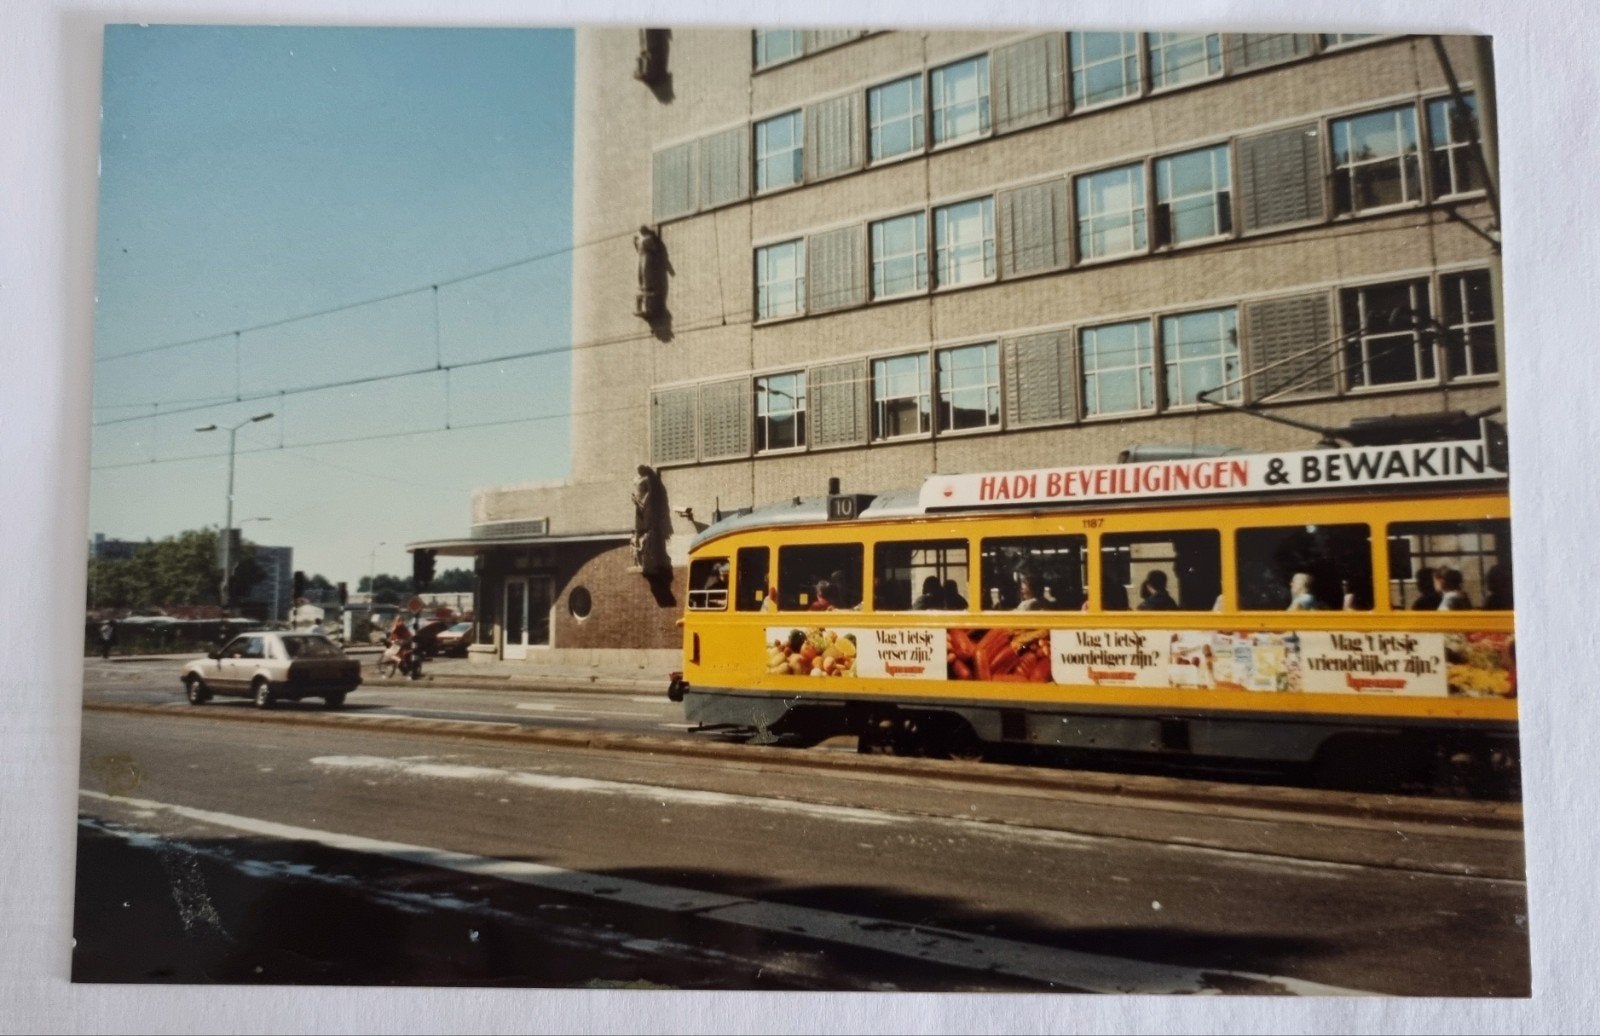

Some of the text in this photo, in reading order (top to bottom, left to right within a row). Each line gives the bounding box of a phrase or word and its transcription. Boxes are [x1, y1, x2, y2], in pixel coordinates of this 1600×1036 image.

[980, 445, 1485, 500] HADI BEVEILIGINGEN & BEWAKIN
[836, 499, 852, 515] 10
[1082, 518, 1104, 528] 1187
[876, 630, 897, 645] Mag
[907, 630, 934, 648] ietsje
[1076, 632, 1102, 649] Mag
[1114, 631, 1147, 650] ietsje
[1330, 634, 1363, 654] Mag
[1378, 634, 1419, 655] ietsje
[878, 647, 934, 664] verser zijn?
[1061, 650, 1160, 670] voordeliger zijn?
[1404, 655, 1440, 677] zijn?
